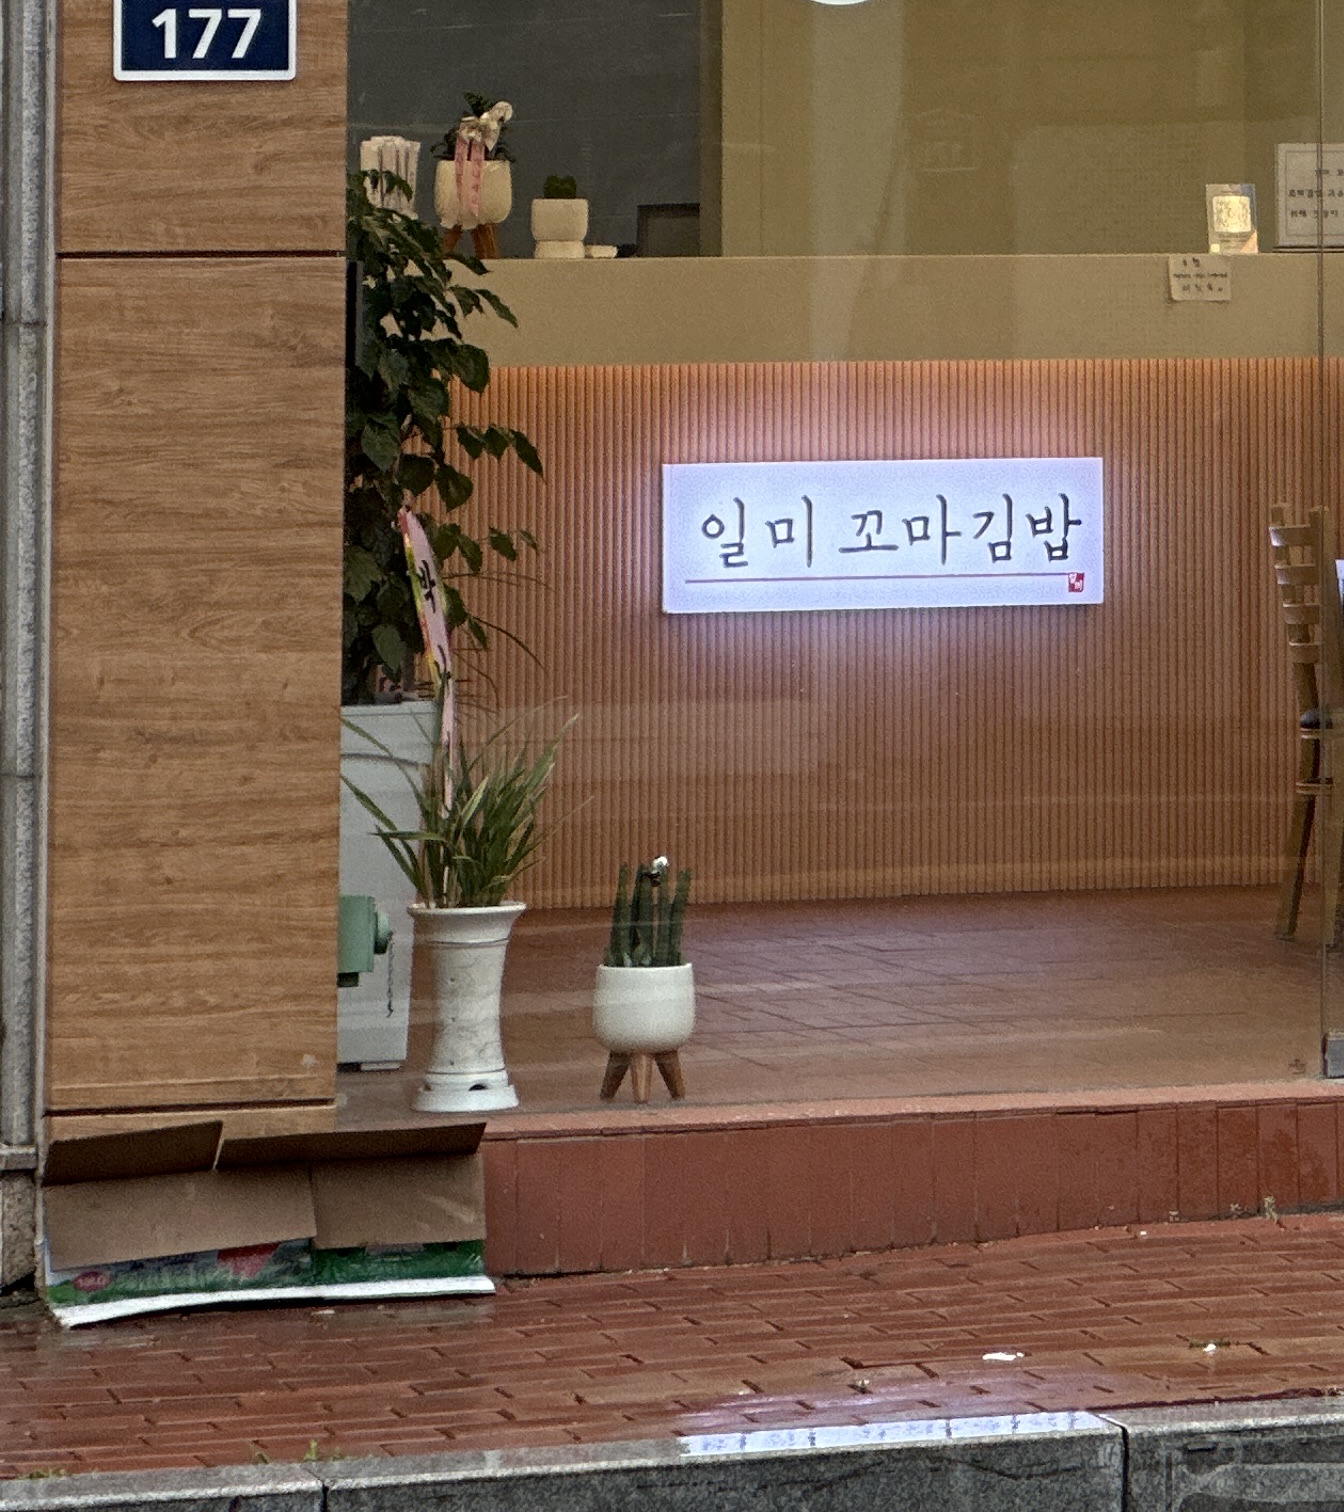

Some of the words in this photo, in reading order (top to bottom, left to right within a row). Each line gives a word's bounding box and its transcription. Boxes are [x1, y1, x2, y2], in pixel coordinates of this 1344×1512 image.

[152, 8, 261, 59] 177
[701, 495, 813, 569] 일미
[838, 492, 1083, 566] 꼬마김밥
